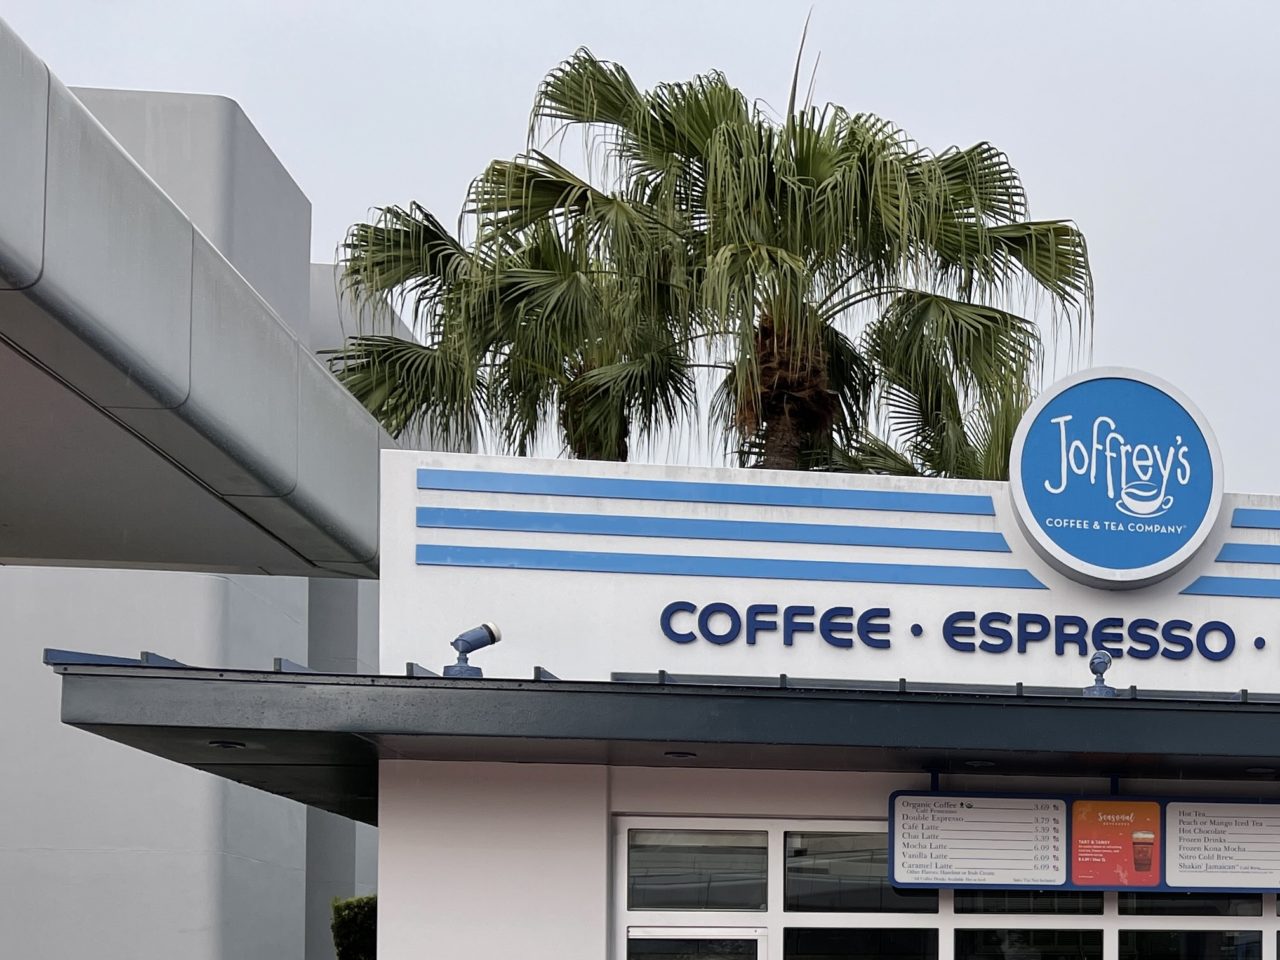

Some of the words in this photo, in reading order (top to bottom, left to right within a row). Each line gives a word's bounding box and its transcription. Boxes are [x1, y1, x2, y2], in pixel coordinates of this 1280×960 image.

[1044, 414, 1191, 499] Joffrey's
[1046, 518, 1089, 530] COFFEE
[1092, 521, 1100, 530] &
[1104, 522, 1124, 531] TEA
[1128, 523, 1184, 534] COMPANY
[660, 600, 891, 648] COFFEE
[942, 611, 1236, 662] ESPRESSO
[902, 801, 932, 810] Organic
[1098, 812, 1135, 823] Seasonal
